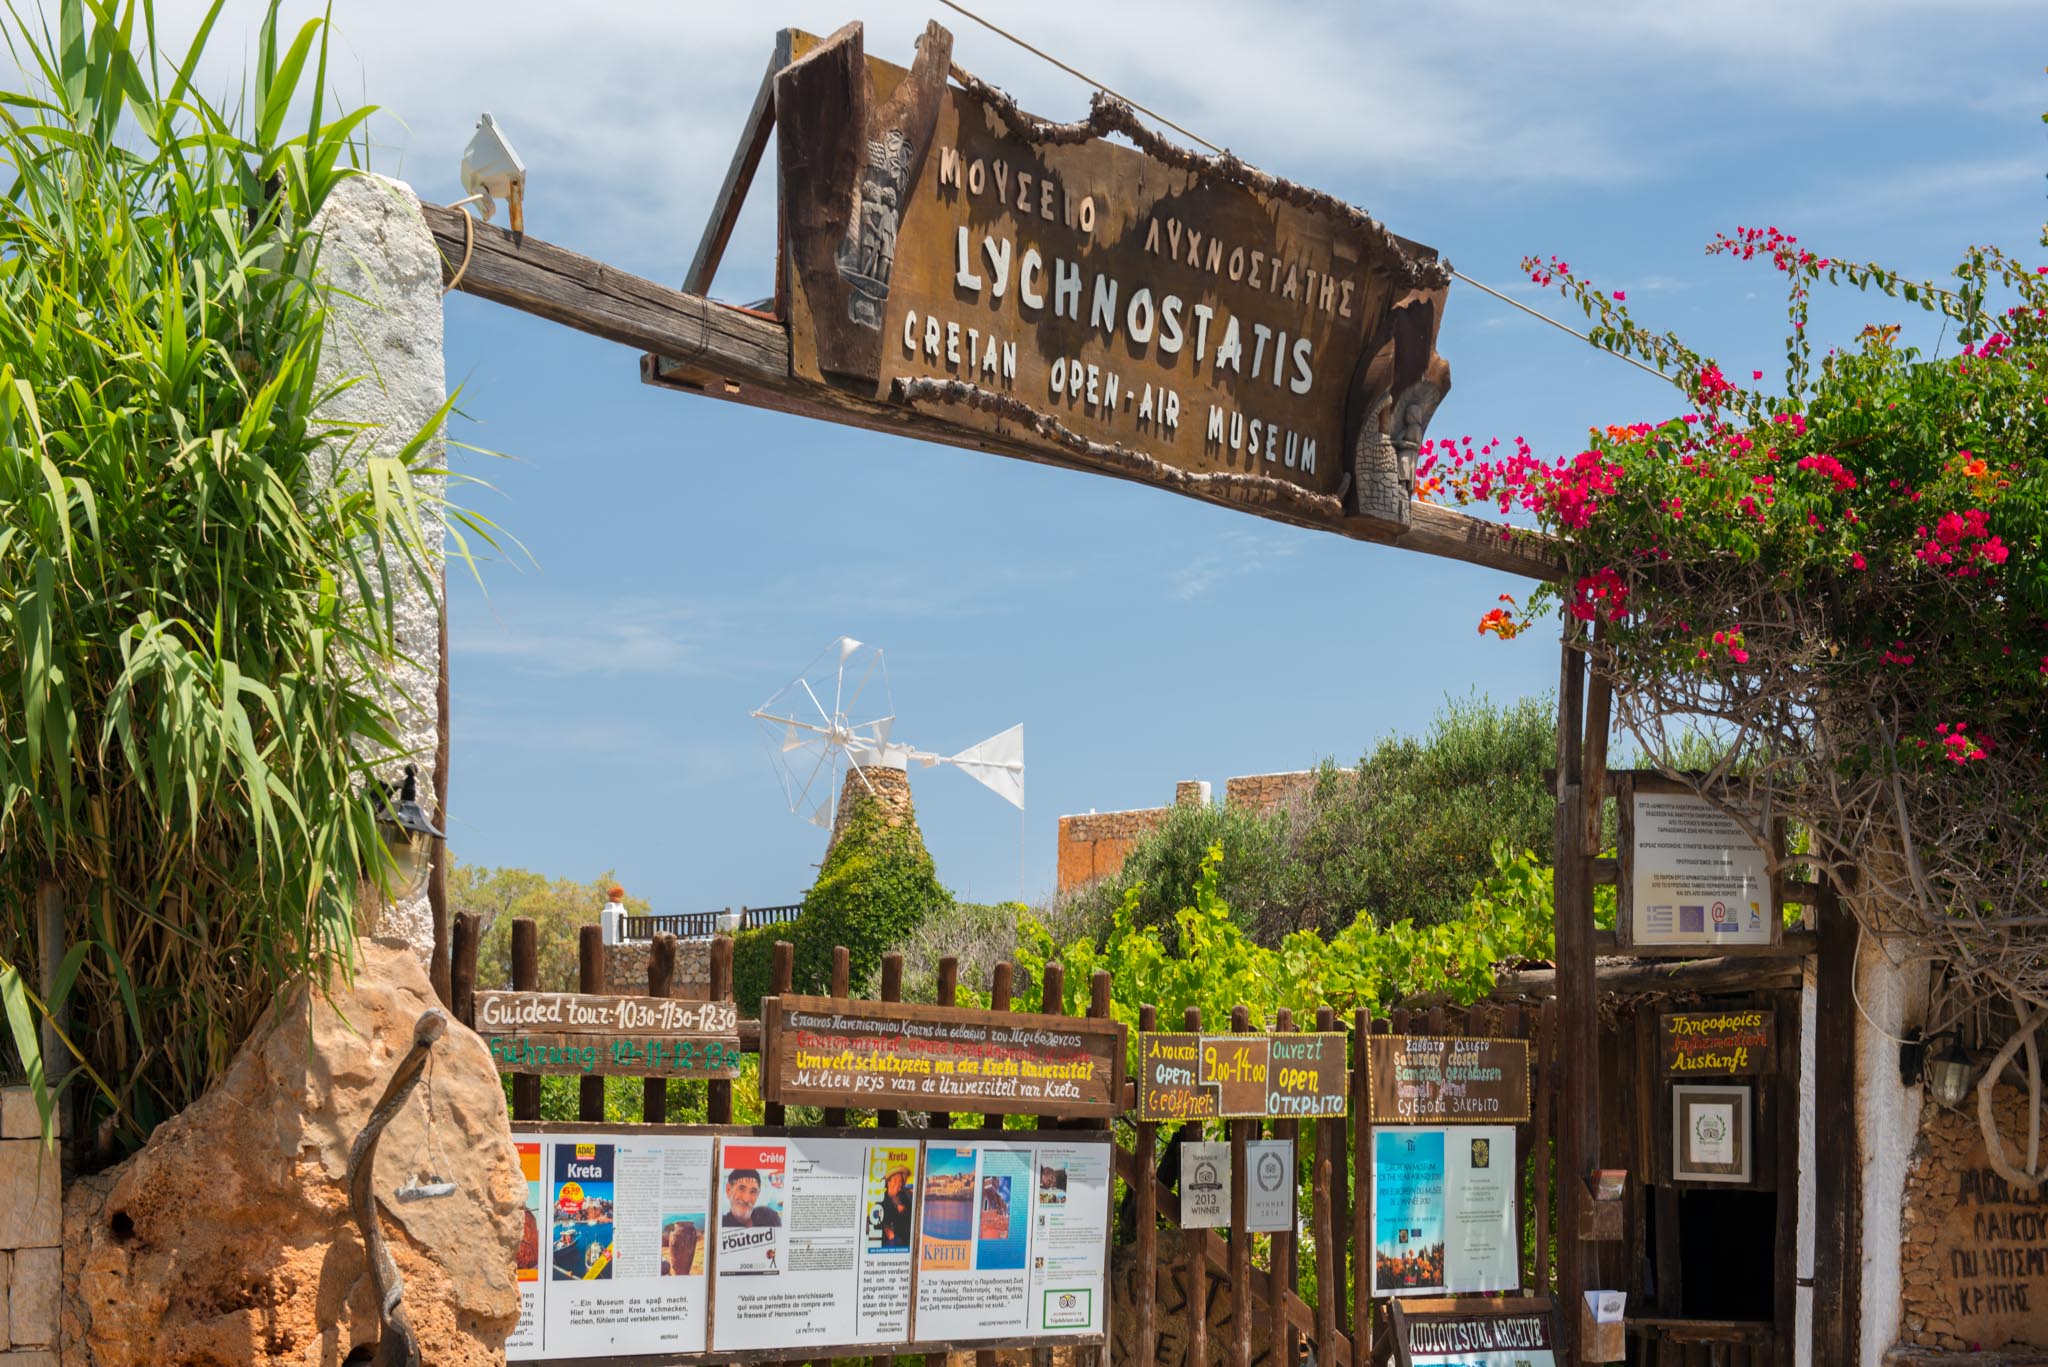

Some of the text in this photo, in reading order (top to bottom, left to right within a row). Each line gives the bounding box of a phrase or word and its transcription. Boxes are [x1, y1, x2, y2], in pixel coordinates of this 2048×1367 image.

[940, 146, 1355, 318] ΜΟΥΣΕΙΟ ΛΥΧΝΟΣΤΑΤΗΣ
[956, 226, 1314, 395] LYCHNOSTATIS
[904, 309, 1317, 476] CRETAN OPEN-AIR MUSEUM
[483, 997, 562, 1025] Guided
[566, 998, 613, 1025] tour:
[1668, 1011, 1762, 1036] Πληροφορίες
[1273, 1035, 1323, 1060] Ouvert
[935, 1060, 954, 1074] von
[957, 1058, 979, 1075] der
[981, 1057, 1019, 1076] Kreta
[1020, 1059, 1095, 1082] Universität
[1393, 1051, 1479, 1067] Saturday closed
[791, 1070, 850, 1089] Milieu
[891, 1077, 916, 1091] van
[921, 1077, 936, 1093] de
[939, 1076, 1018, 1097] Universiteit
[1020, 1083, 1041, 1097] van
[1044, 1080, 1080, 1099] Kreta
[1155, 1064, 1196, 1086] Open:
[1279, 1067, 1319, 1093] open
[1395, 1065, 1442, 1085] Samstag
[577, 1146, 594, 1155] ADAC
[759, 1152, 785, 1164] Crète
[888, 1152, 908, 1161] Kreta
[567, 1163, 602, 1179] Kreta
[1191, 1206, 1220, 1215] WINNER
[1194, 1194, 1217, 1205] 2013
[722, 1227, 773, 1250] routard
[570, 1308, 584, 1316] Hier
[617, 1315, 629, 1323] und
[630, 1315, 660, 1323] verstehen
[1408, 1317, 1544, 1353] AUDIOVISUAL ARCHIVE
